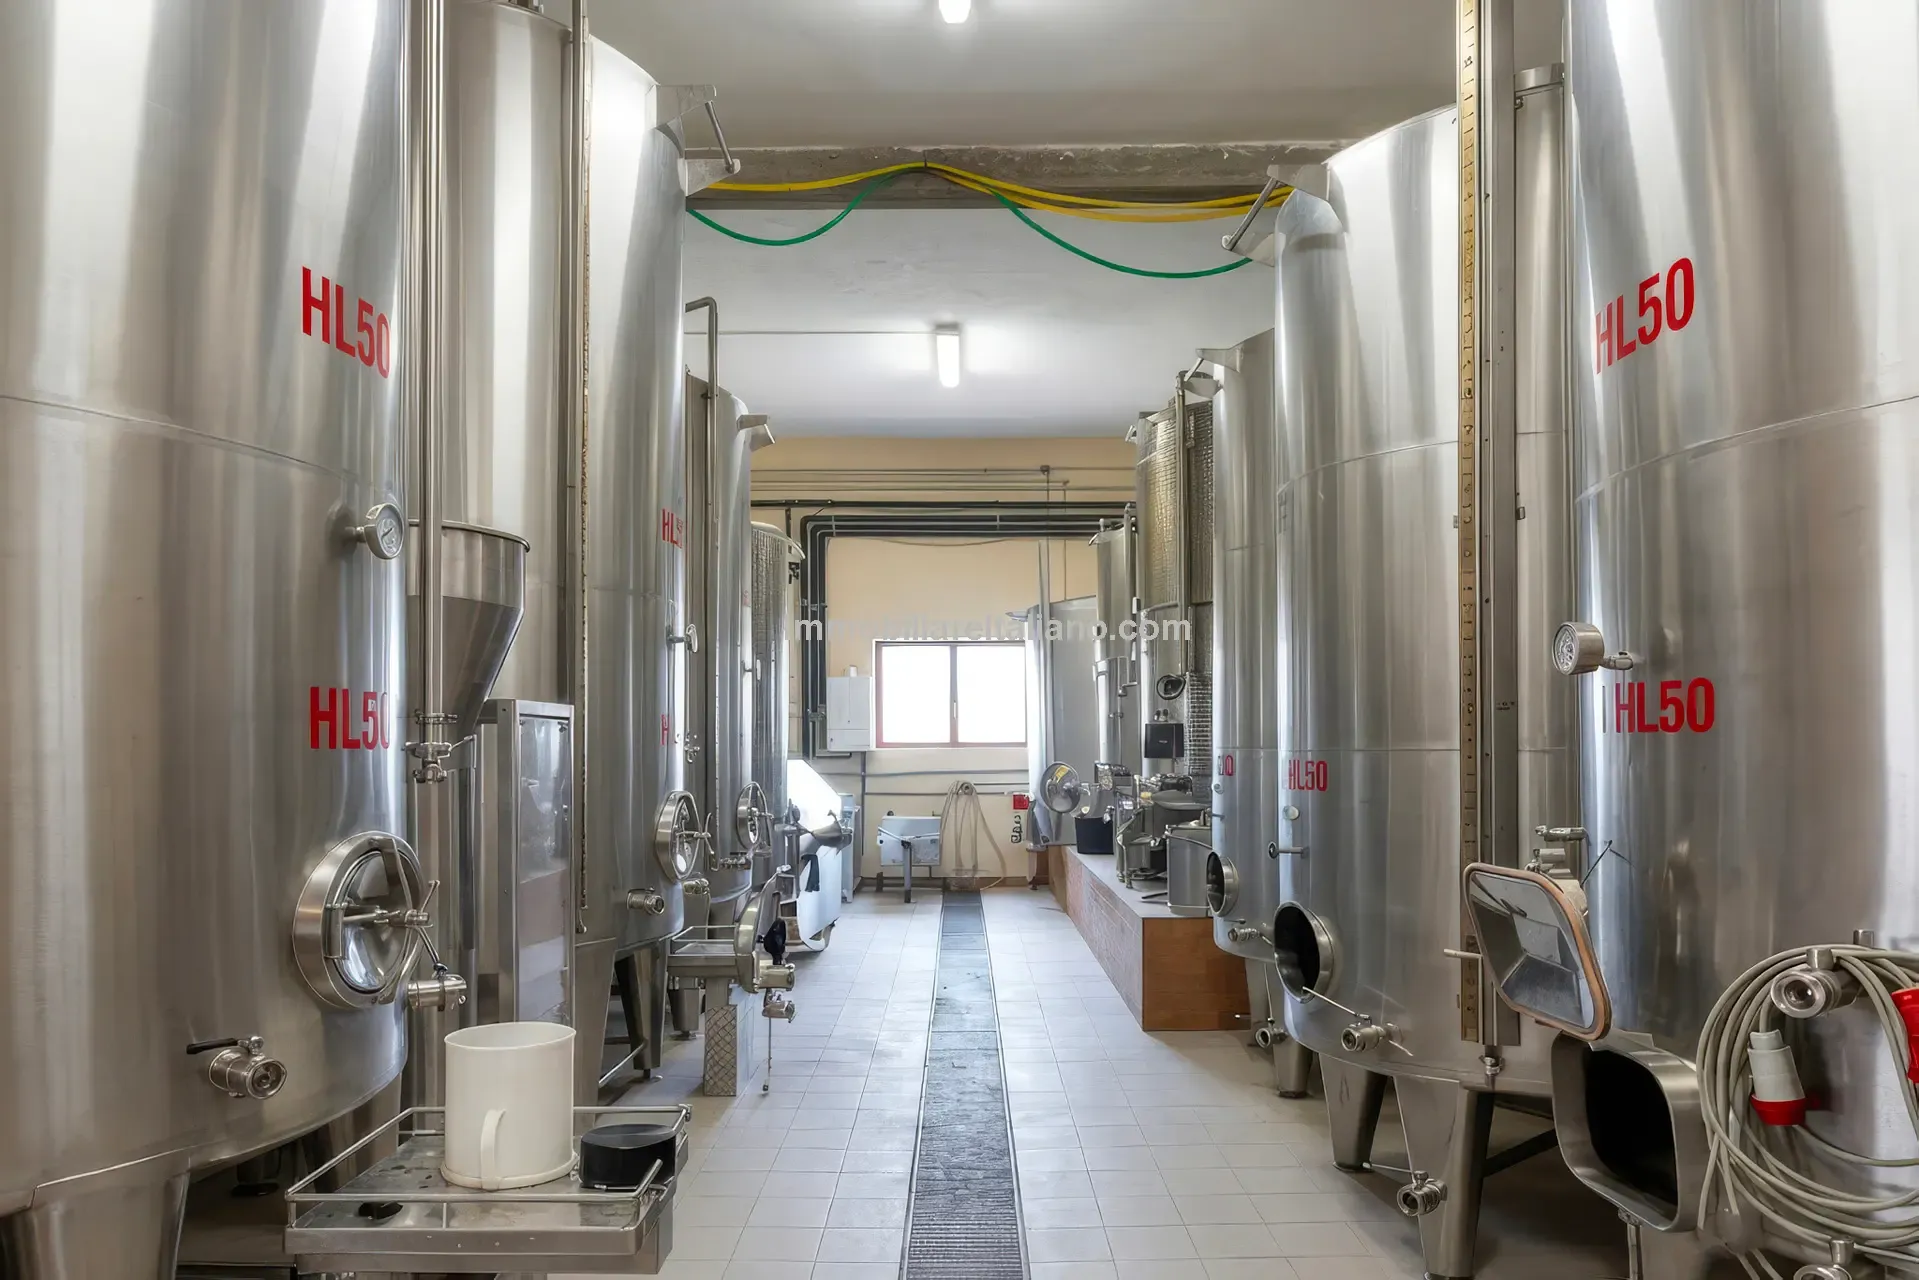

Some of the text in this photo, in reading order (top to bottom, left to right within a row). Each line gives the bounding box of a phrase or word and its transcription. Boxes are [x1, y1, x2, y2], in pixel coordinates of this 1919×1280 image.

[302, 265, 390, 379] HL50
[1595, 258, 1695, 374] HL50
[310, 686, 389, 750] HL50
[1615, 677, 1715, 733] HL50
[1288, 759, 1328, 792] HL50
